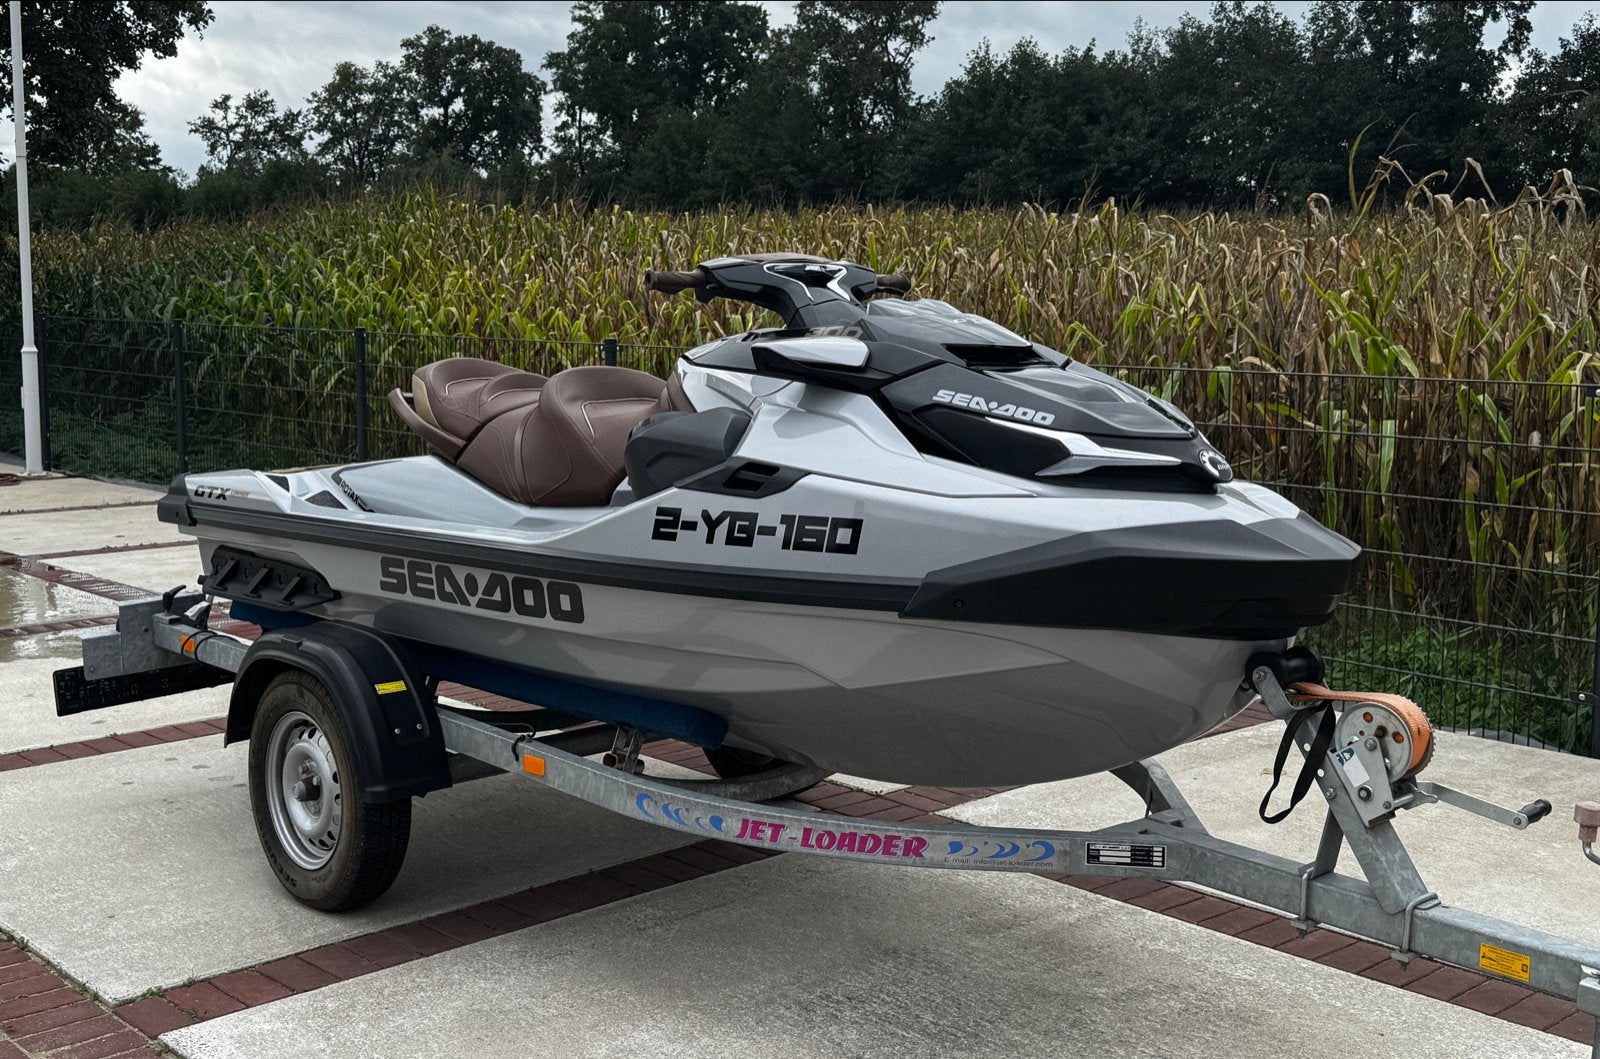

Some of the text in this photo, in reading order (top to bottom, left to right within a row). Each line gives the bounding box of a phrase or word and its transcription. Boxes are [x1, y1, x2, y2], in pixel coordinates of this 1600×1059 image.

[194, 485, 231, 500] GTX
[340, 480, 359, 505] ROTAX
[651, 506, 864, 555] 2-YB-160
